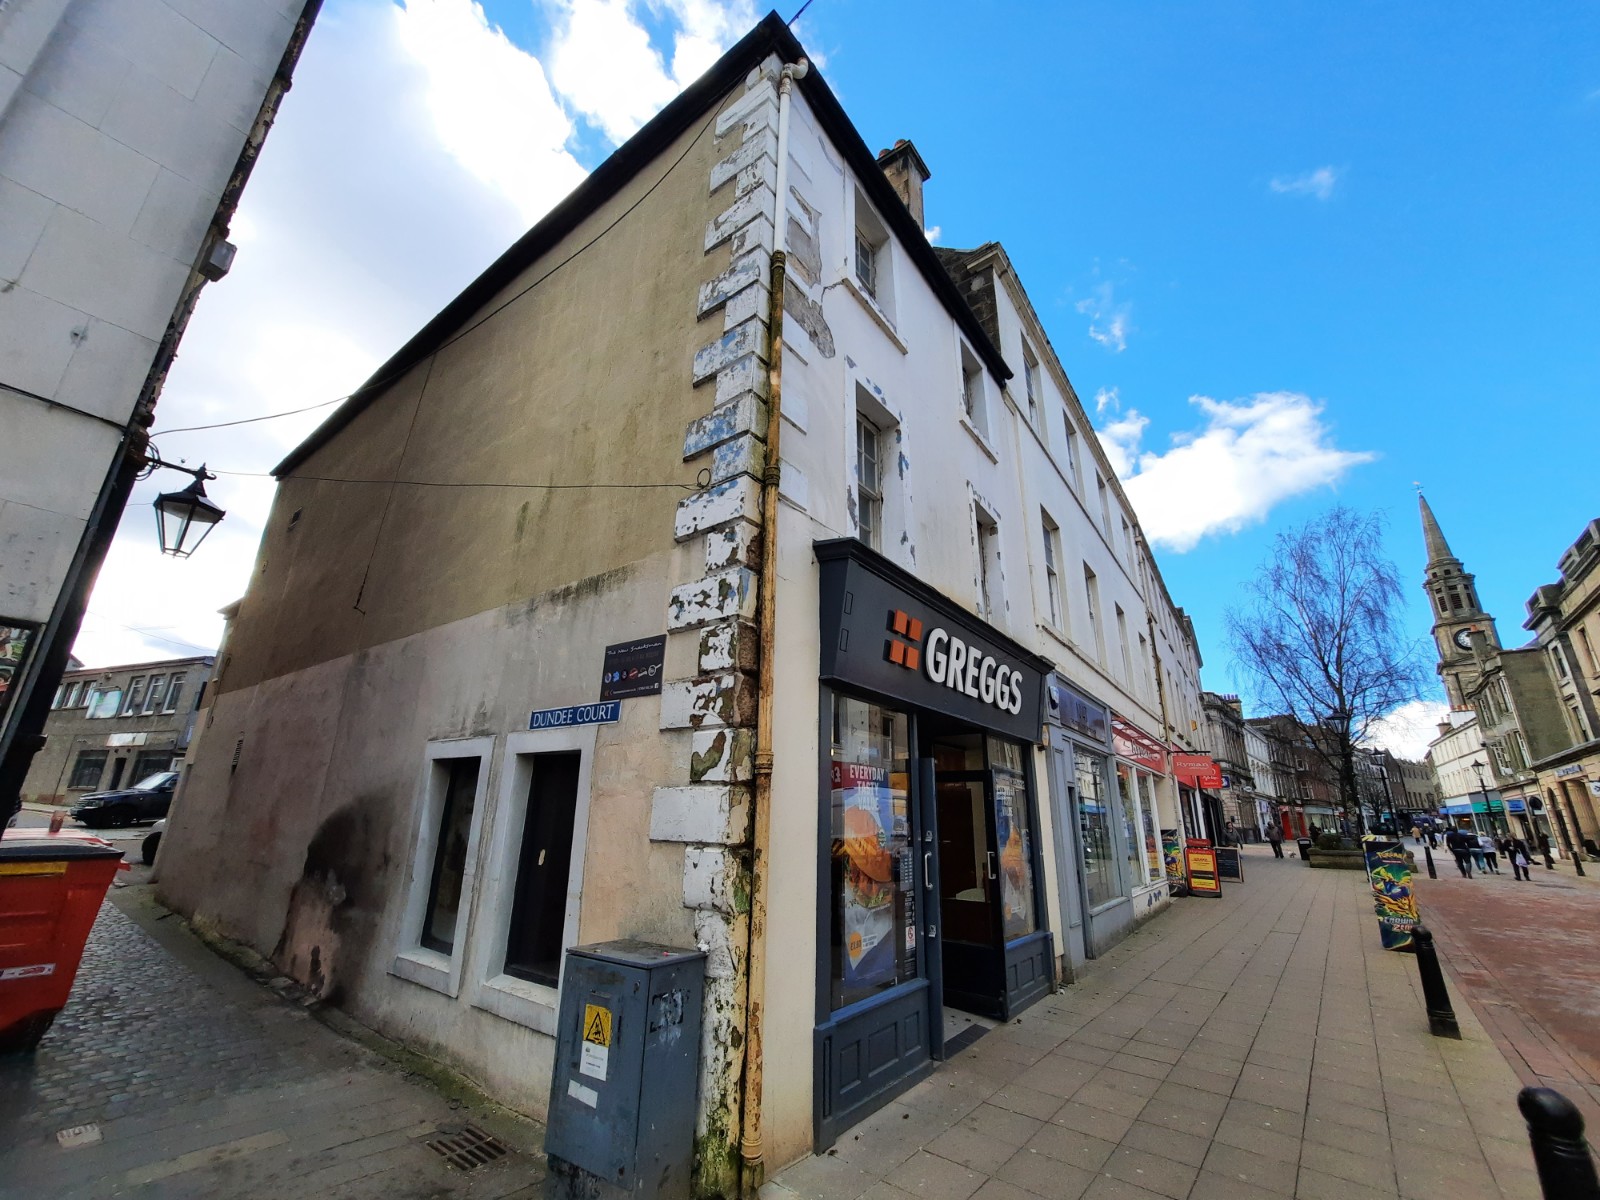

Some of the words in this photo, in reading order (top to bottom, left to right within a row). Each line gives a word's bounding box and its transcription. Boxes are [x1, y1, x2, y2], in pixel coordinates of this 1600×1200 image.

[926, 627, 1023, 715] GREGGS
[533, 709, 574, 727] DUNDEE
[576, 703, 615, 722] COURT
[849, 764, 885, 781] EVERYDAY
